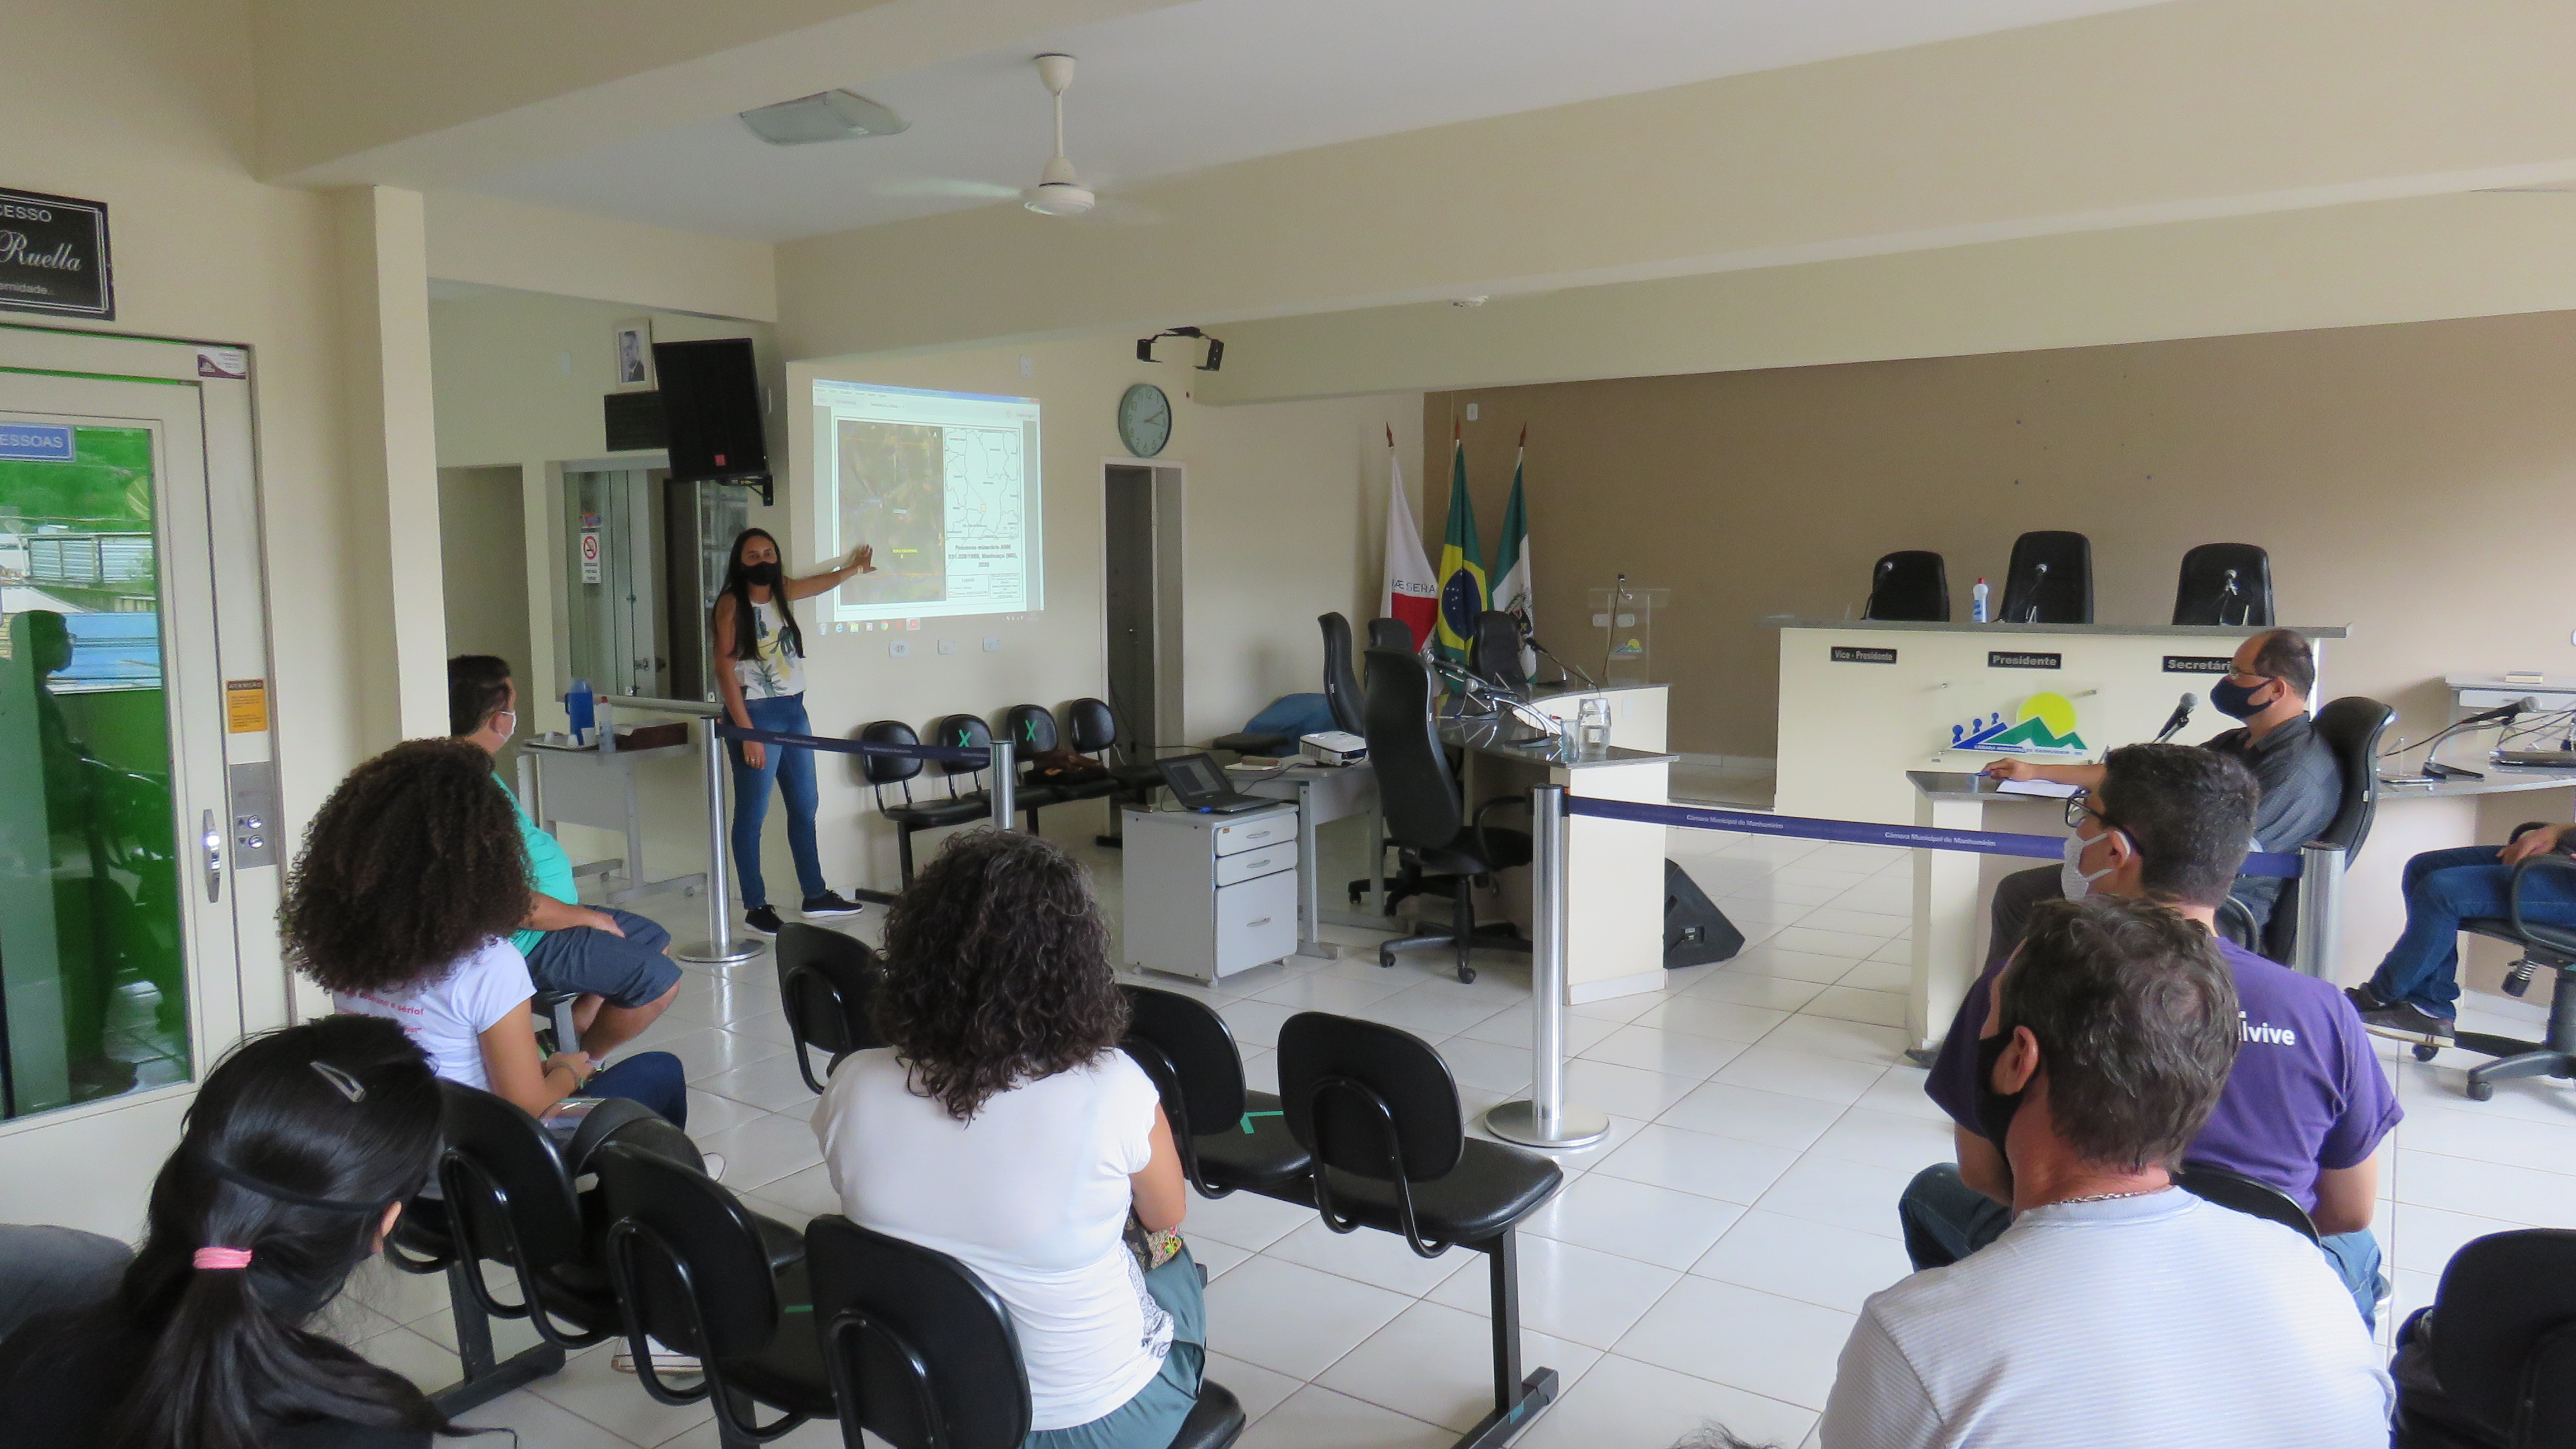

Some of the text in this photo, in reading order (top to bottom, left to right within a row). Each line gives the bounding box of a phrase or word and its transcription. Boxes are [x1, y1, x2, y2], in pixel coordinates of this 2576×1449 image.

[1406, 583, 1436, 593] SERA
[1835, 650, 1850, 659] Vice
[1855, 650, 1893, 661] Presidente
[1992, 655, 2057, 666] Presidente
[1710, 817, 1737, 825] Municipal
[1911, 834, 1943, 842] Municipal
[2238, 1021, 2295, 1046] lvive
